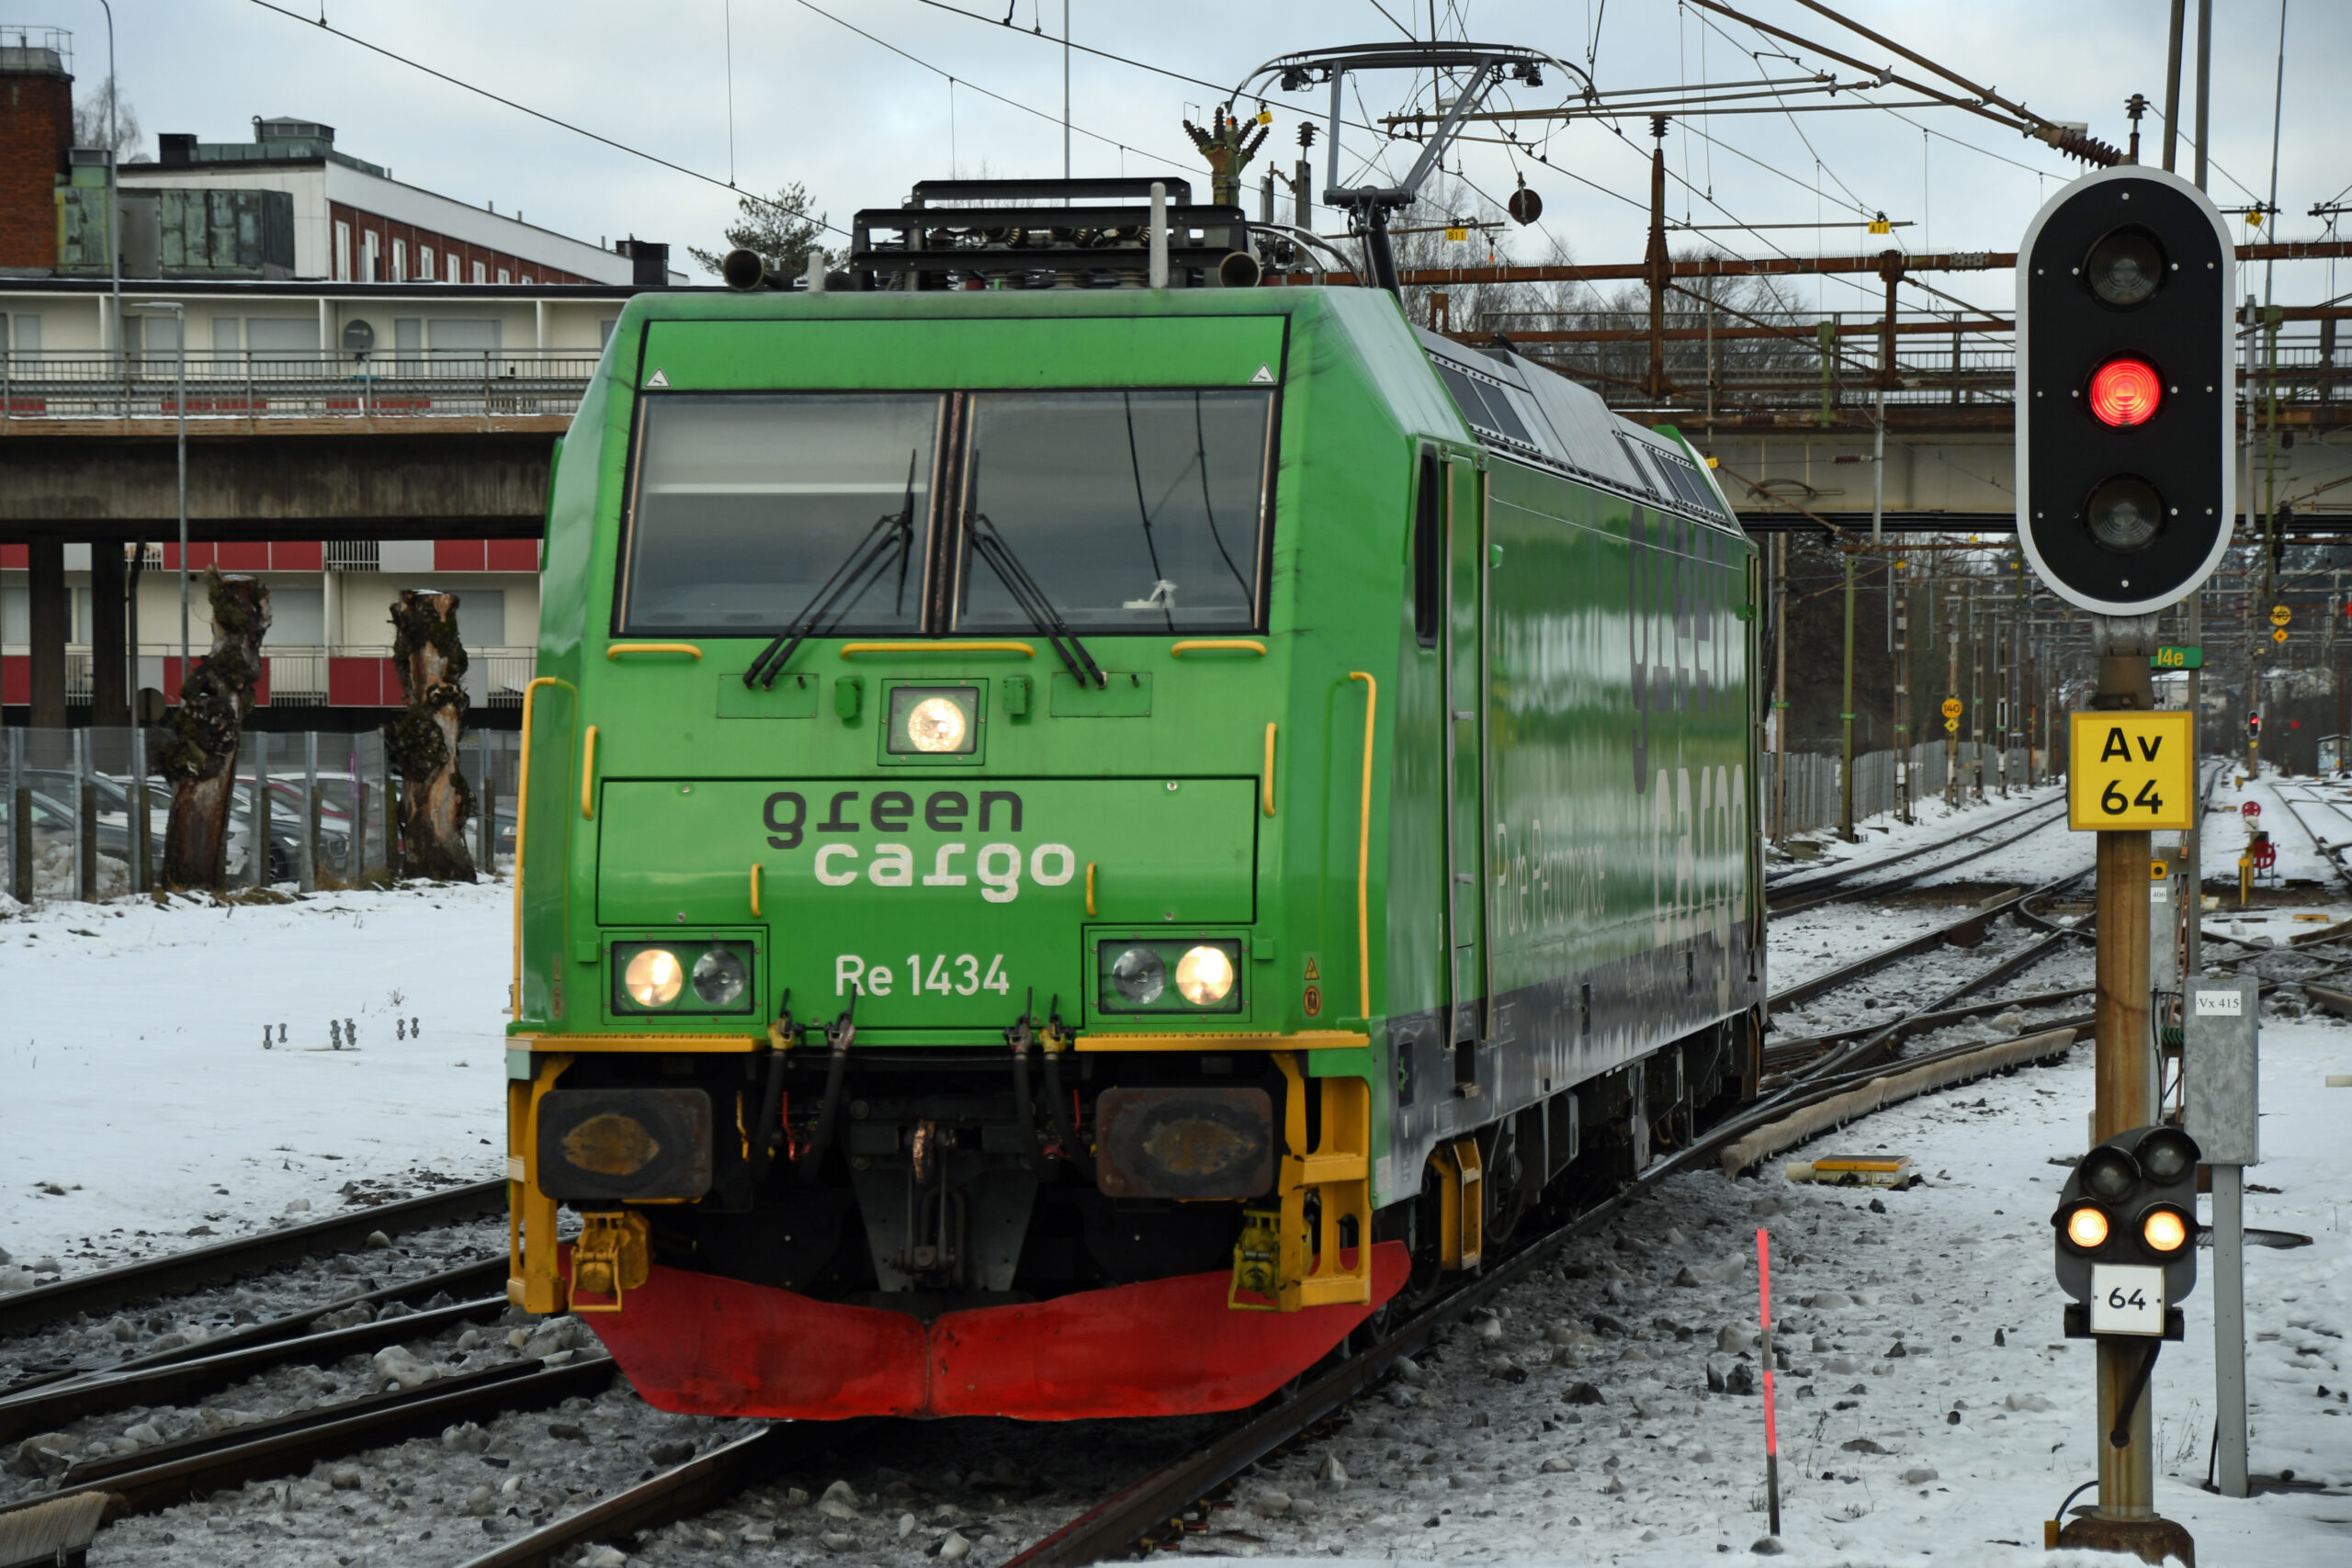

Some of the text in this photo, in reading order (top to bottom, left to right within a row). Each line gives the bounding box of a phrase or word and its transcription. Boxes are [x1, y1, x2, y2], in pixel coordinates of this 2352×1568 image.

[1943, 704, 1961, 714] 140
[2100, 728, 2163, 762] Av
[2101, 779, 2163, 816] 64
[763, 791, 1023, 850] green
[814, 843, 1076, 903] cargo
[1497, 823, 1529, 938] Pure
[835, 953, 1010, 997] Re 1434
[2199, 998, 2240, 1009] Vx 415
[2109, 1287, 2146, 1312] 64
